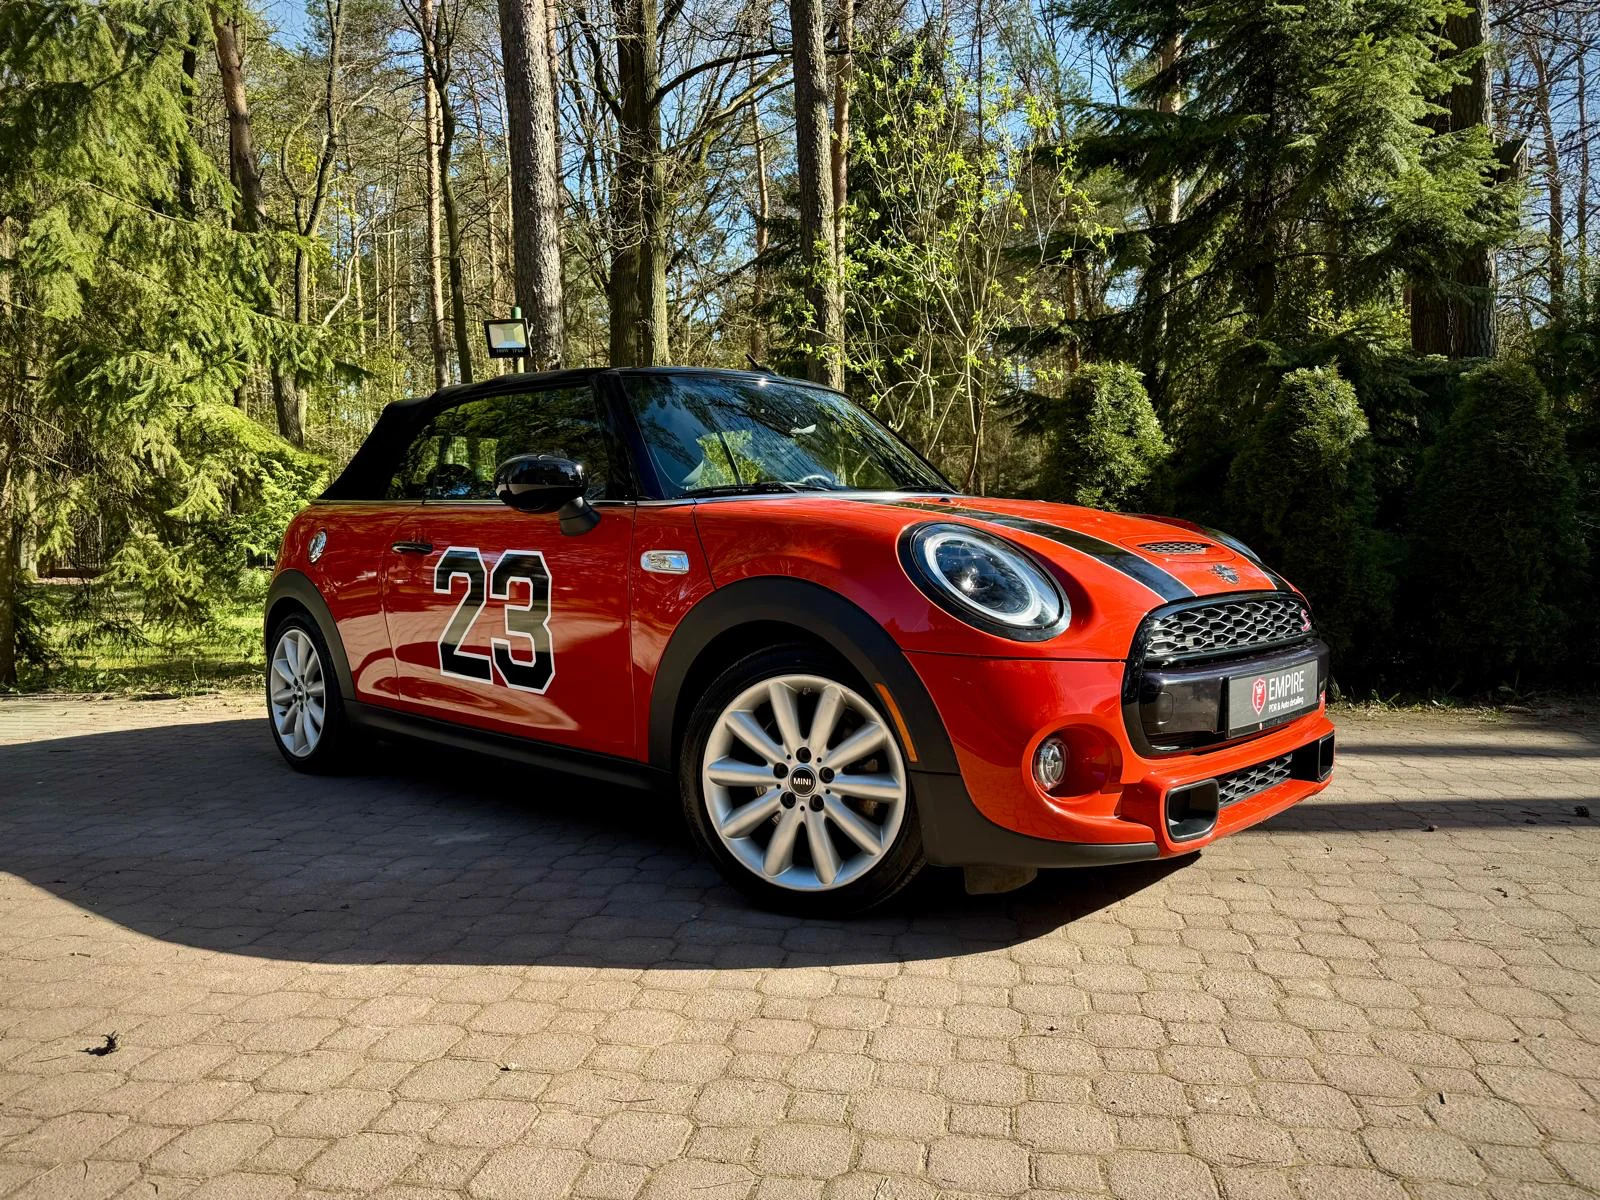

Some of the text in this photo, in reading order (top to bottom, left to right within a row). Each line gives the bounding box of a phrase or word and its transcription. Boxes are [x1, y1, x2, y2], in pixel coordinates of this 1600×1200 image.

[433, 546, 556, 695] 23
[1268, 670, 1305, 701] EMPIRE
[1281, 700, 1290, 709] Auto
[793, 777, 812, 786] MINI
